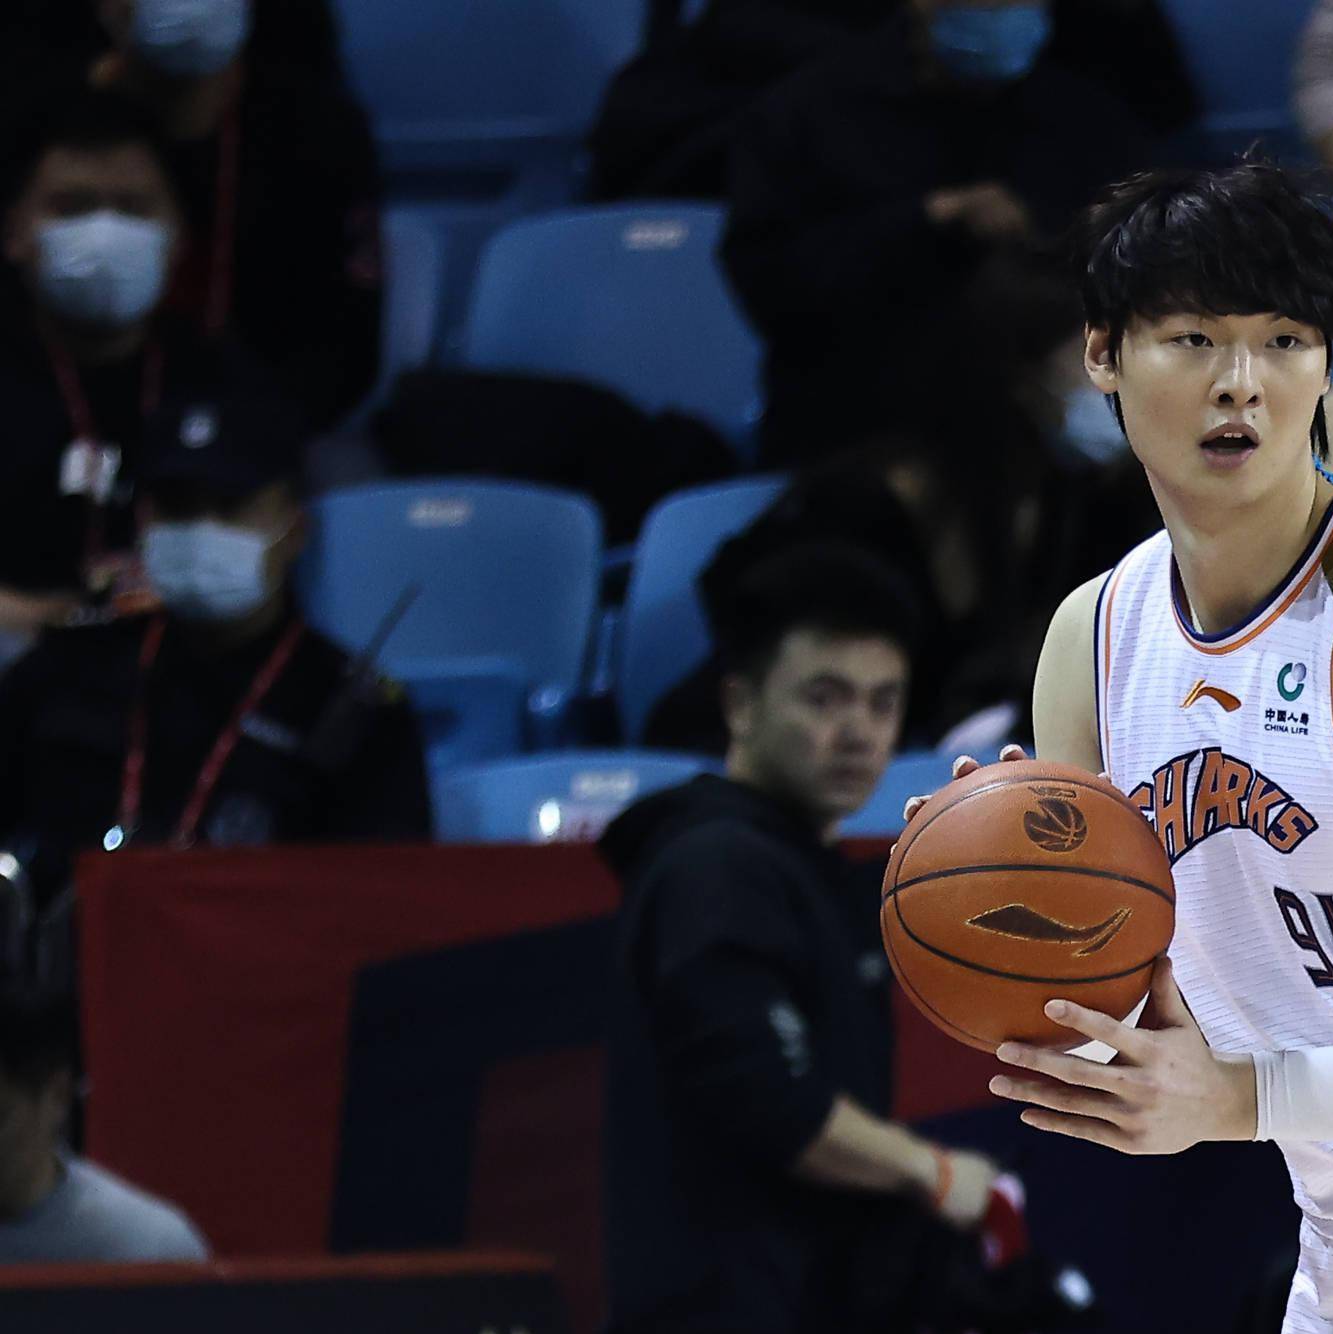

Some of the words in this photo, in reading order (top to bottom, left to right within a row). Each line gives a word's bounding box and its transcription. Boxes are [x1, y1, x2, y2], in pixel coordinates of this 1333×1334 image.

[1264, 723, 1289, 733] CHINA
[1291, 726, 1309, 736] LIFE
[1127, 745, 1320, 868] HARKS
